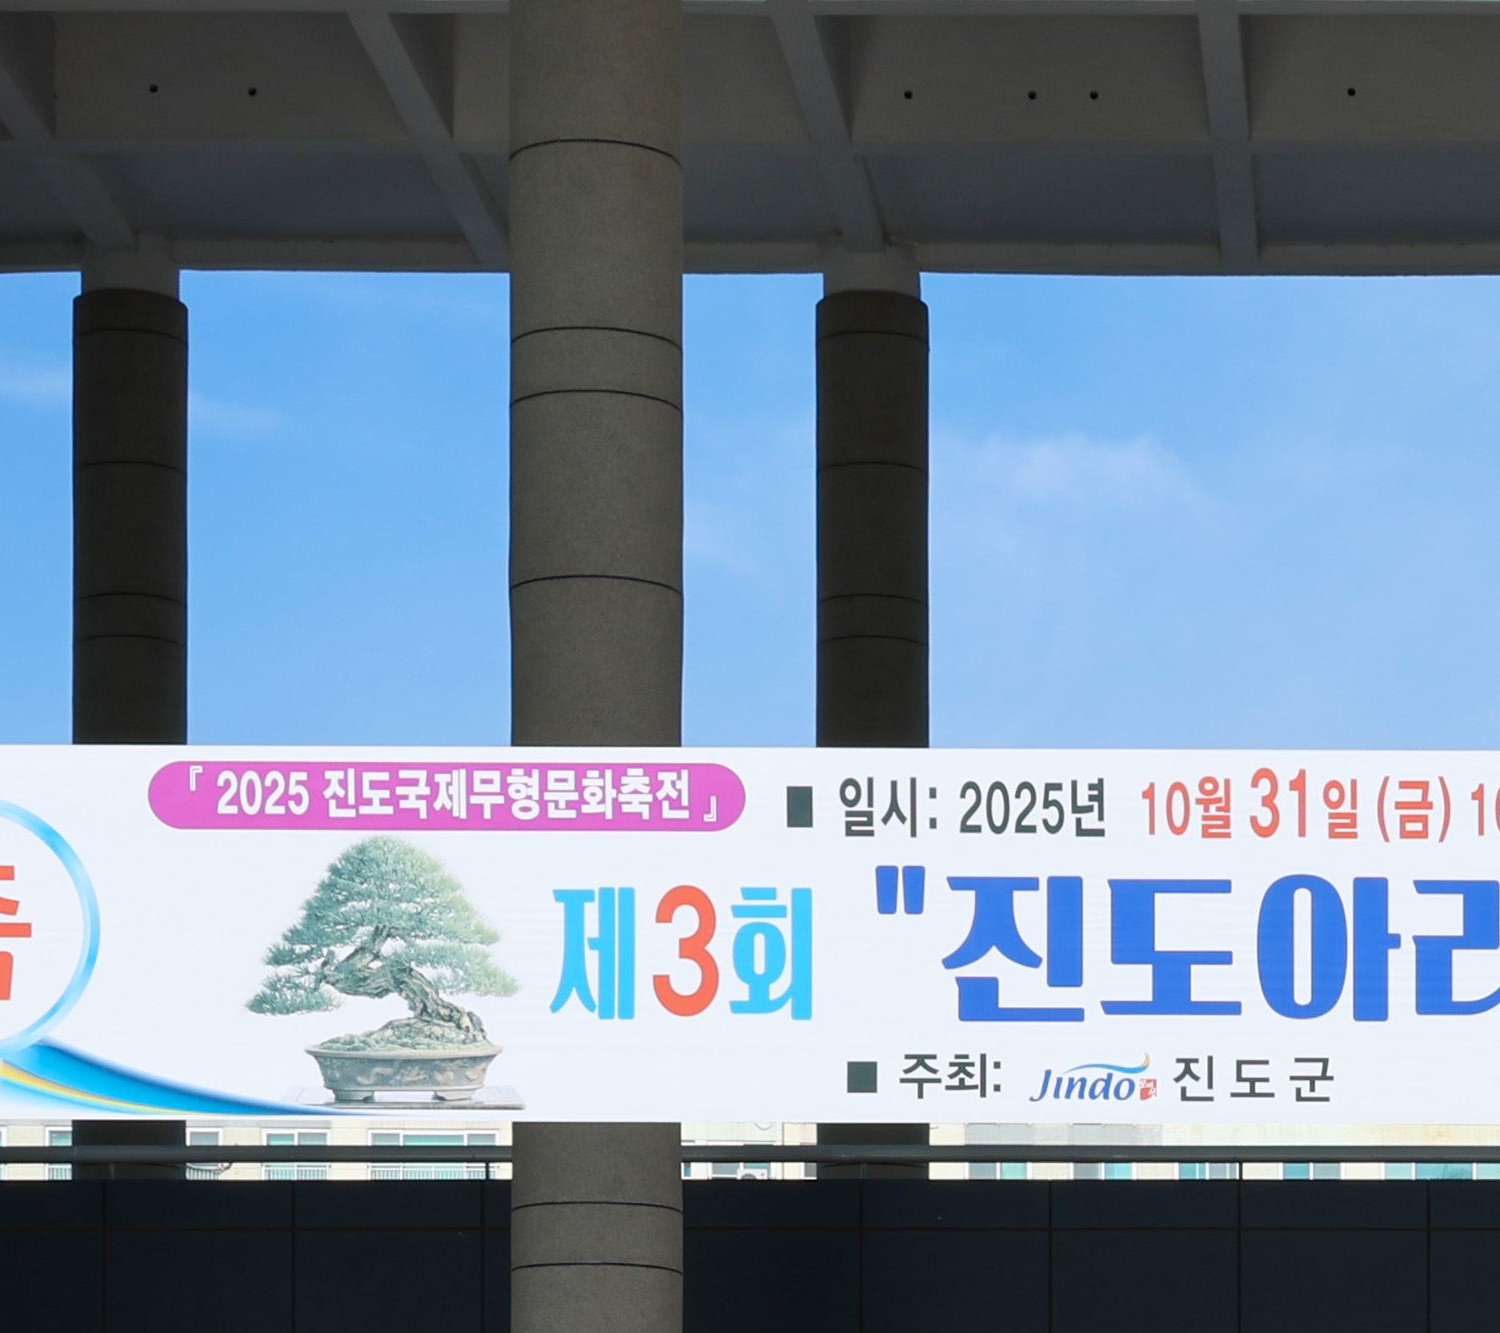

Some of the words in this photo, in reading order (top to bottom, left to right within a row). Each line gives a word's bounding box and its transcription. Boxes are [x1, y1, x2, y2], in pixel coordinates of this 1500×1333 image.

[216, 769, 310, 816] 2025
[322, 767, 692, 821] 진도국제무형문화축전
[840, 777, 937, 837] 일시:
[960, 778, 1105, 837] 2025년
[1142, 776, 1232, 839] 10월
[1249, 767, 1359, 839] 31일
[1376, 775, 1452, 843] (금)
[551, 882, 814, 1021] 제3회
[900, 1054, 1001, 1100] 주최:
[1029, 1069, 1136, 1102] Jindo
[1173, 1056, 1334, 1102] 진도군
